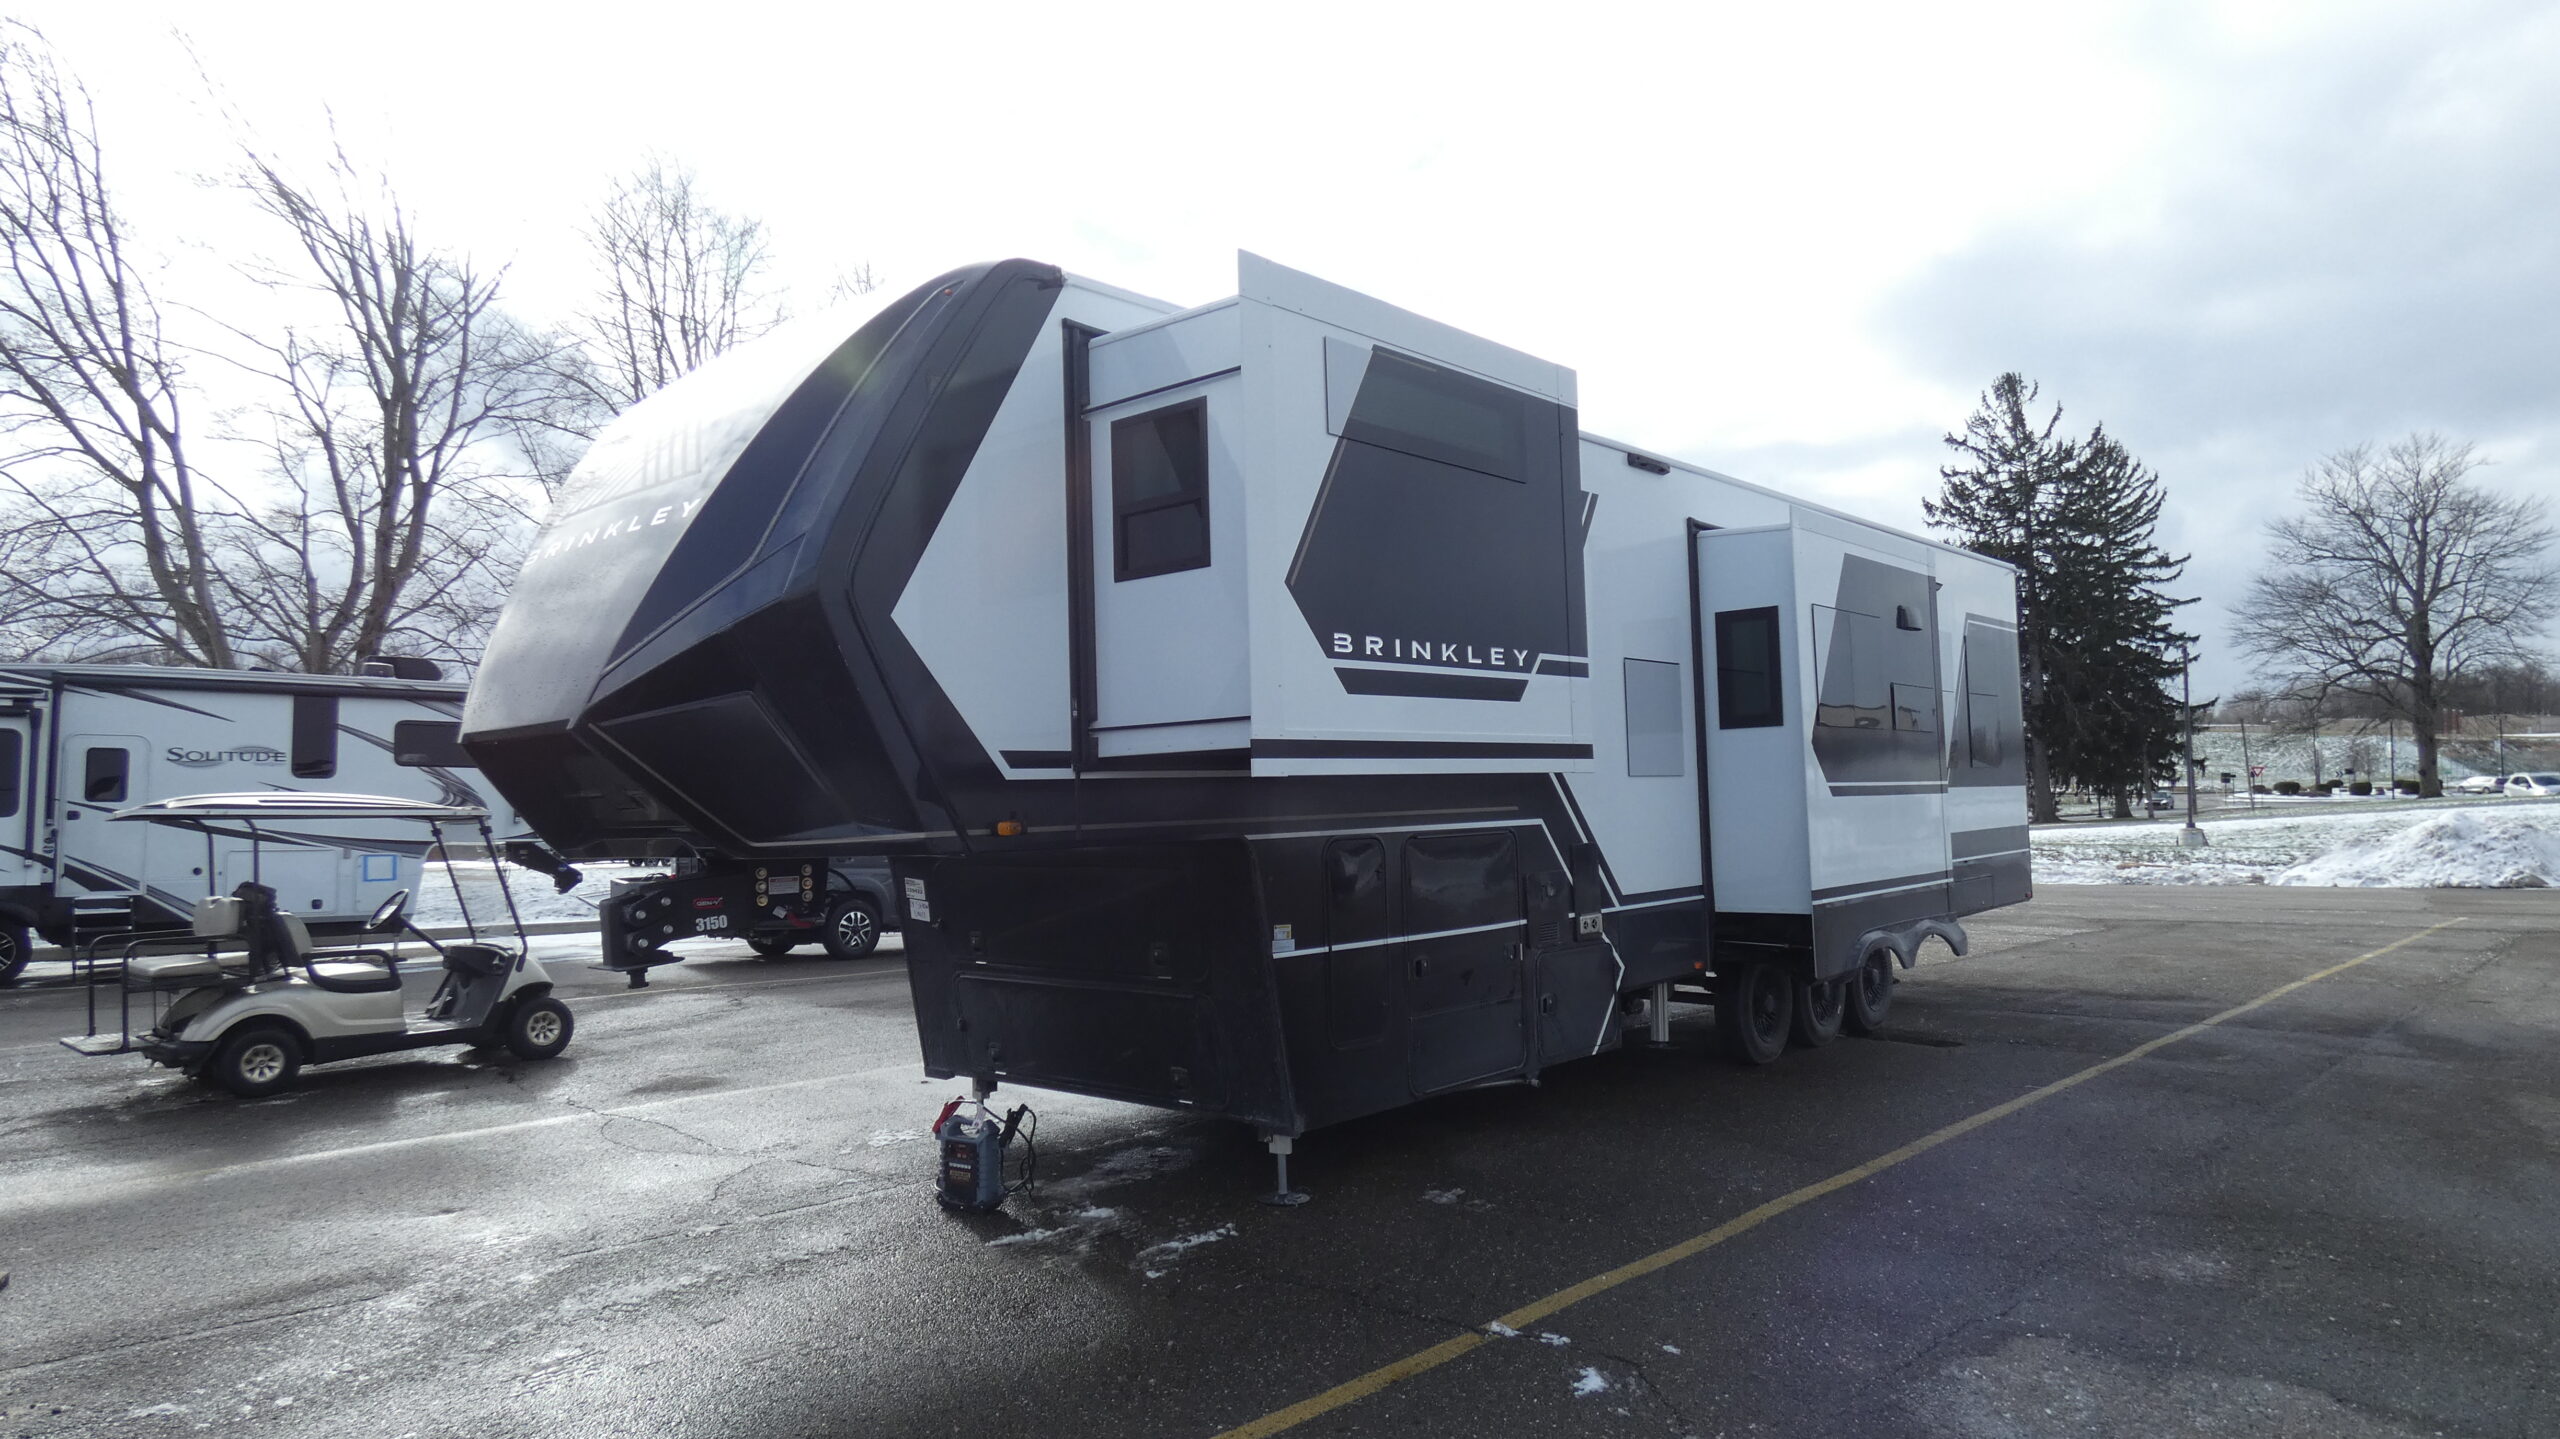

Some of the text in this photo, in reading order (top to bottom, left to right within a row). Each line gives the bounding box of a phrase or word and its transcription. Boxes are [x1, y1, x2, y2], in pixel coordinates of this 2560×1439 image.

[1333, 632, 1529, 667] BRINKLEY
[166, 747, 287, 762] SOLITUDE
[695, 914, 728, 932] 3150
